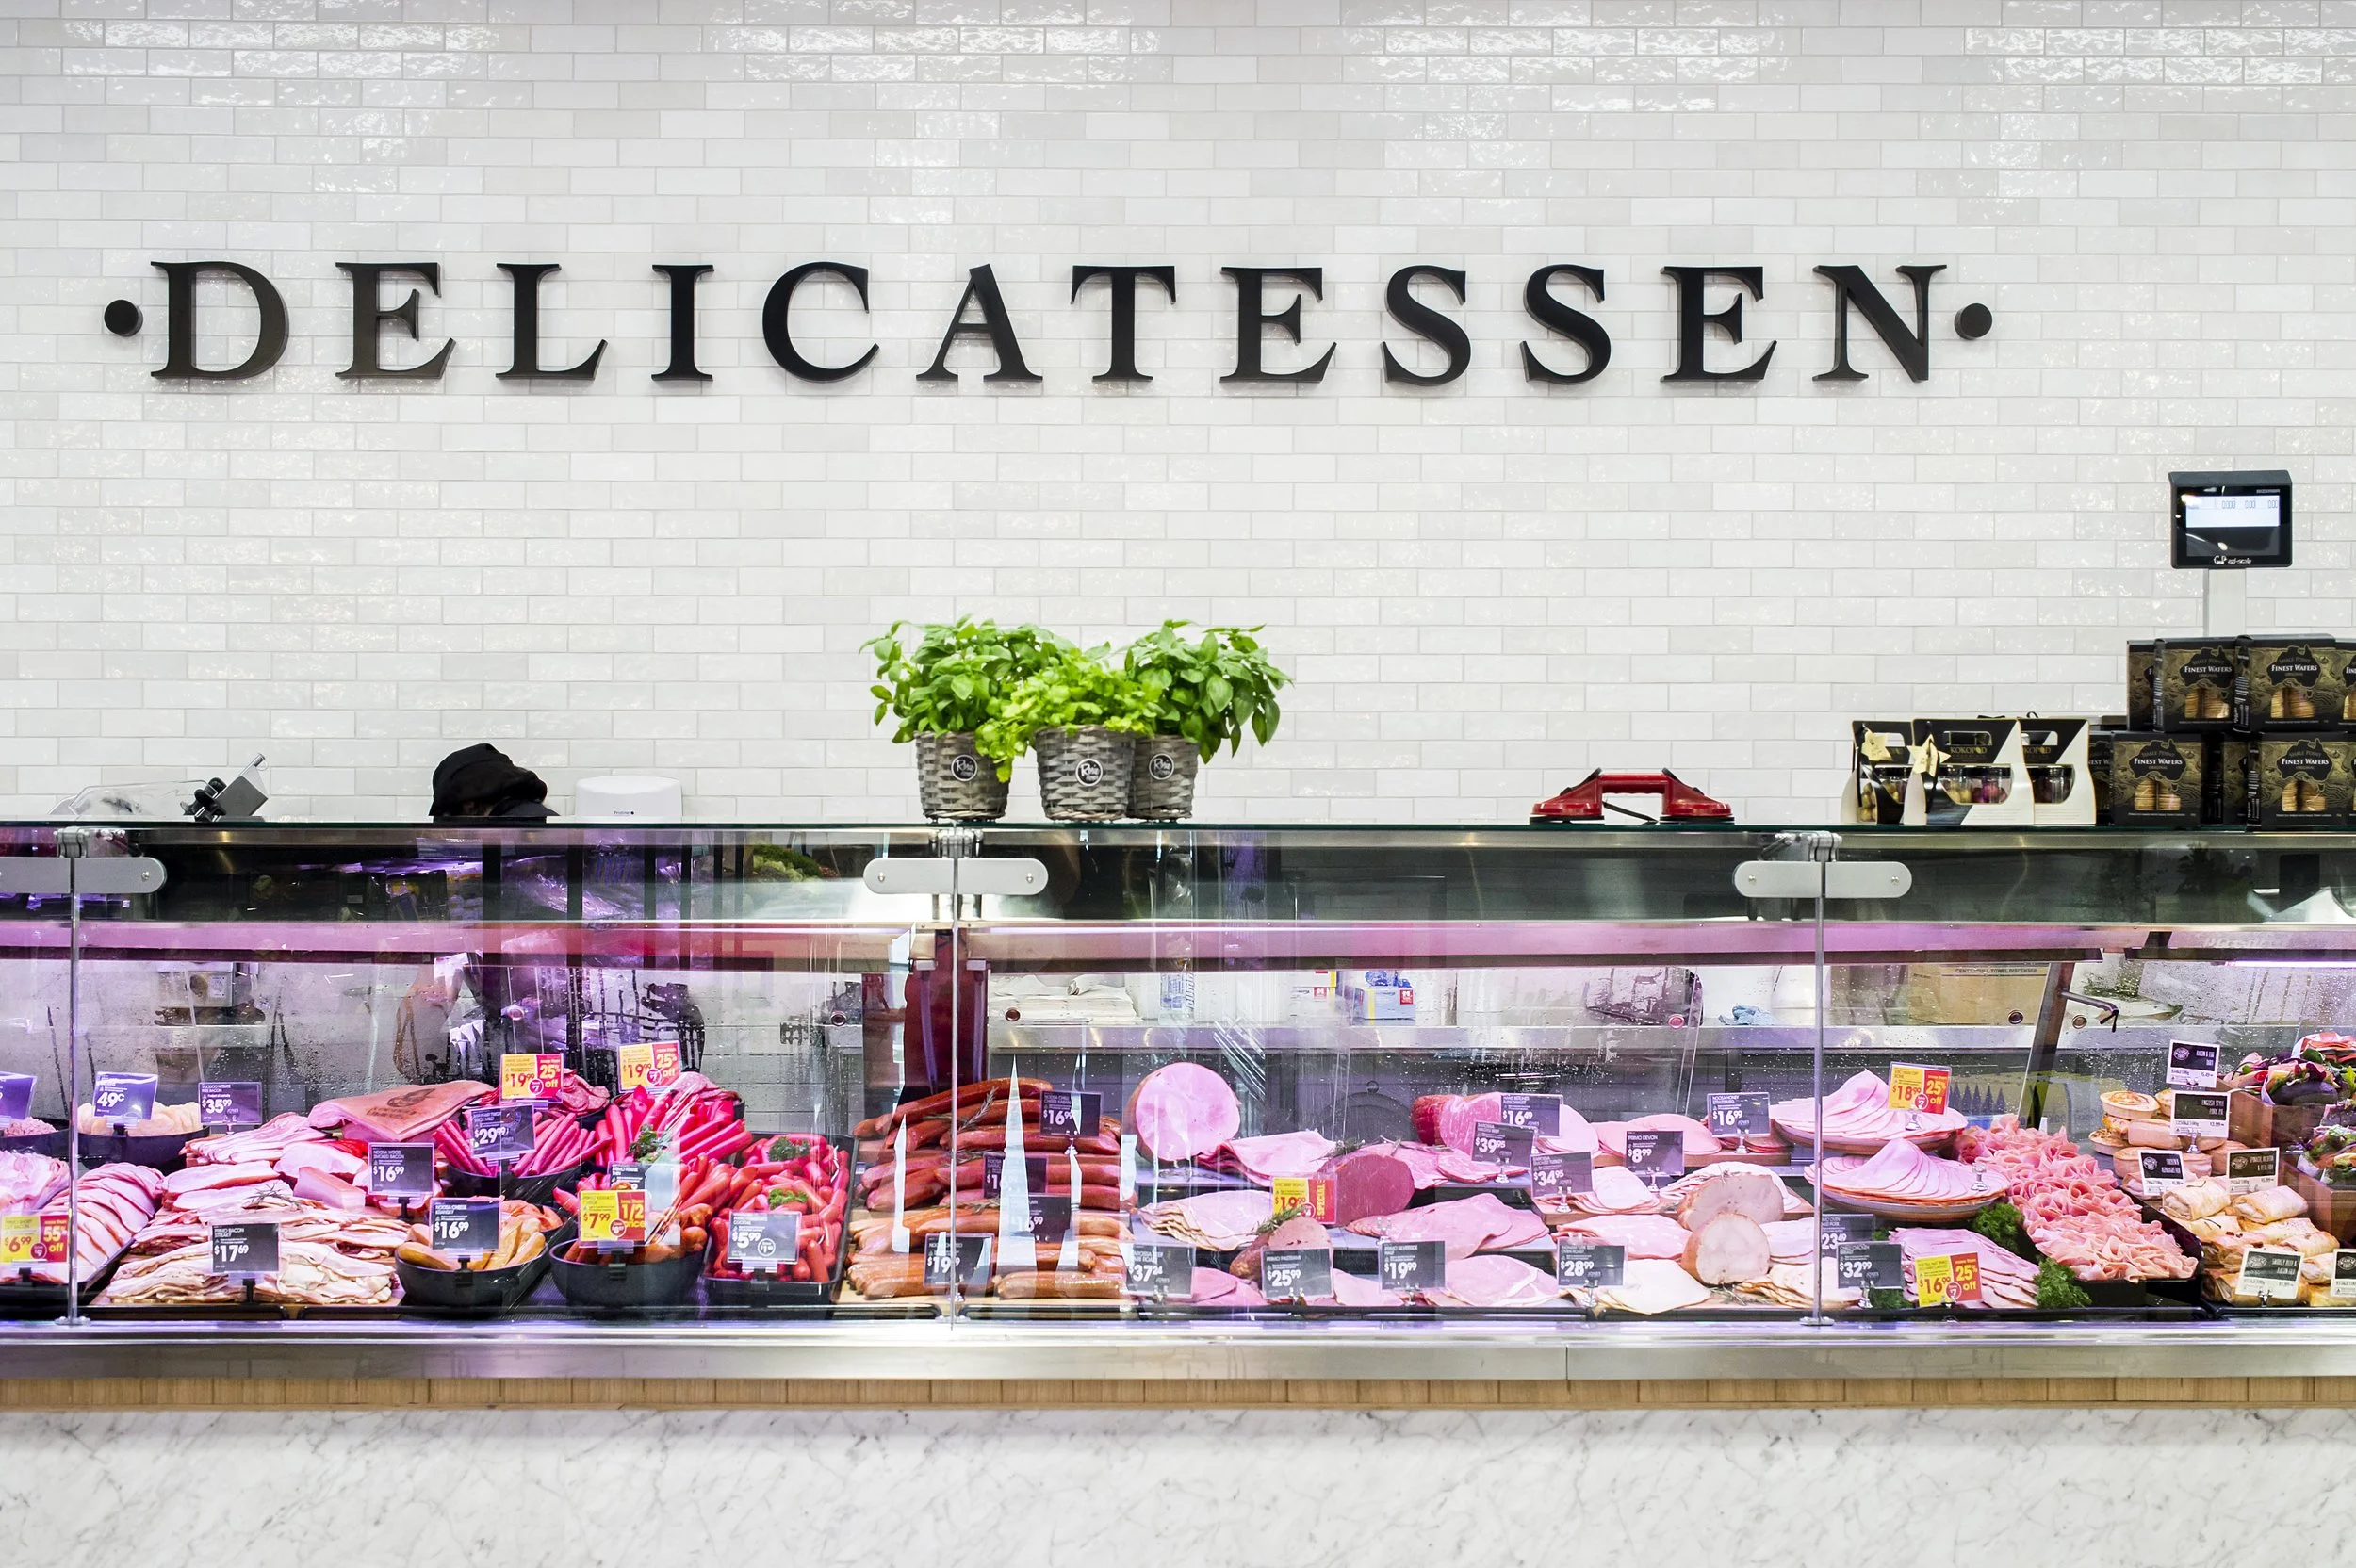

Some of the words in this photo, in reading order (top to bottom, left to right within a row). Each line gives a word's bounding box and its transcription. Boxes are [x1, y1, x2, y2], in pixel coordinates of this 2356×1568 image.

[150, 262, 1947, 384] DELICATESSEN
[656, 1053, 678, 1069] 25%
[540, 1064, 562, 1079] 25%
[663, 1068, 676, 1077] off
[545, 1079, 559, 1088] off
[1926, 1080, 1947, 1096] 25%
[1930, 1096, 1943, 1105] off
[1317, 1184, 1326, 1217] SPECIAL
[622, 1204, 645, 1221] 1/2
[49, 1242, 64, 1252] off
[927, 1256, 961, 1273] $199
[1955, 1265, 1977, 1282] 25%
[1963, 1281, 1977, 1291] off
